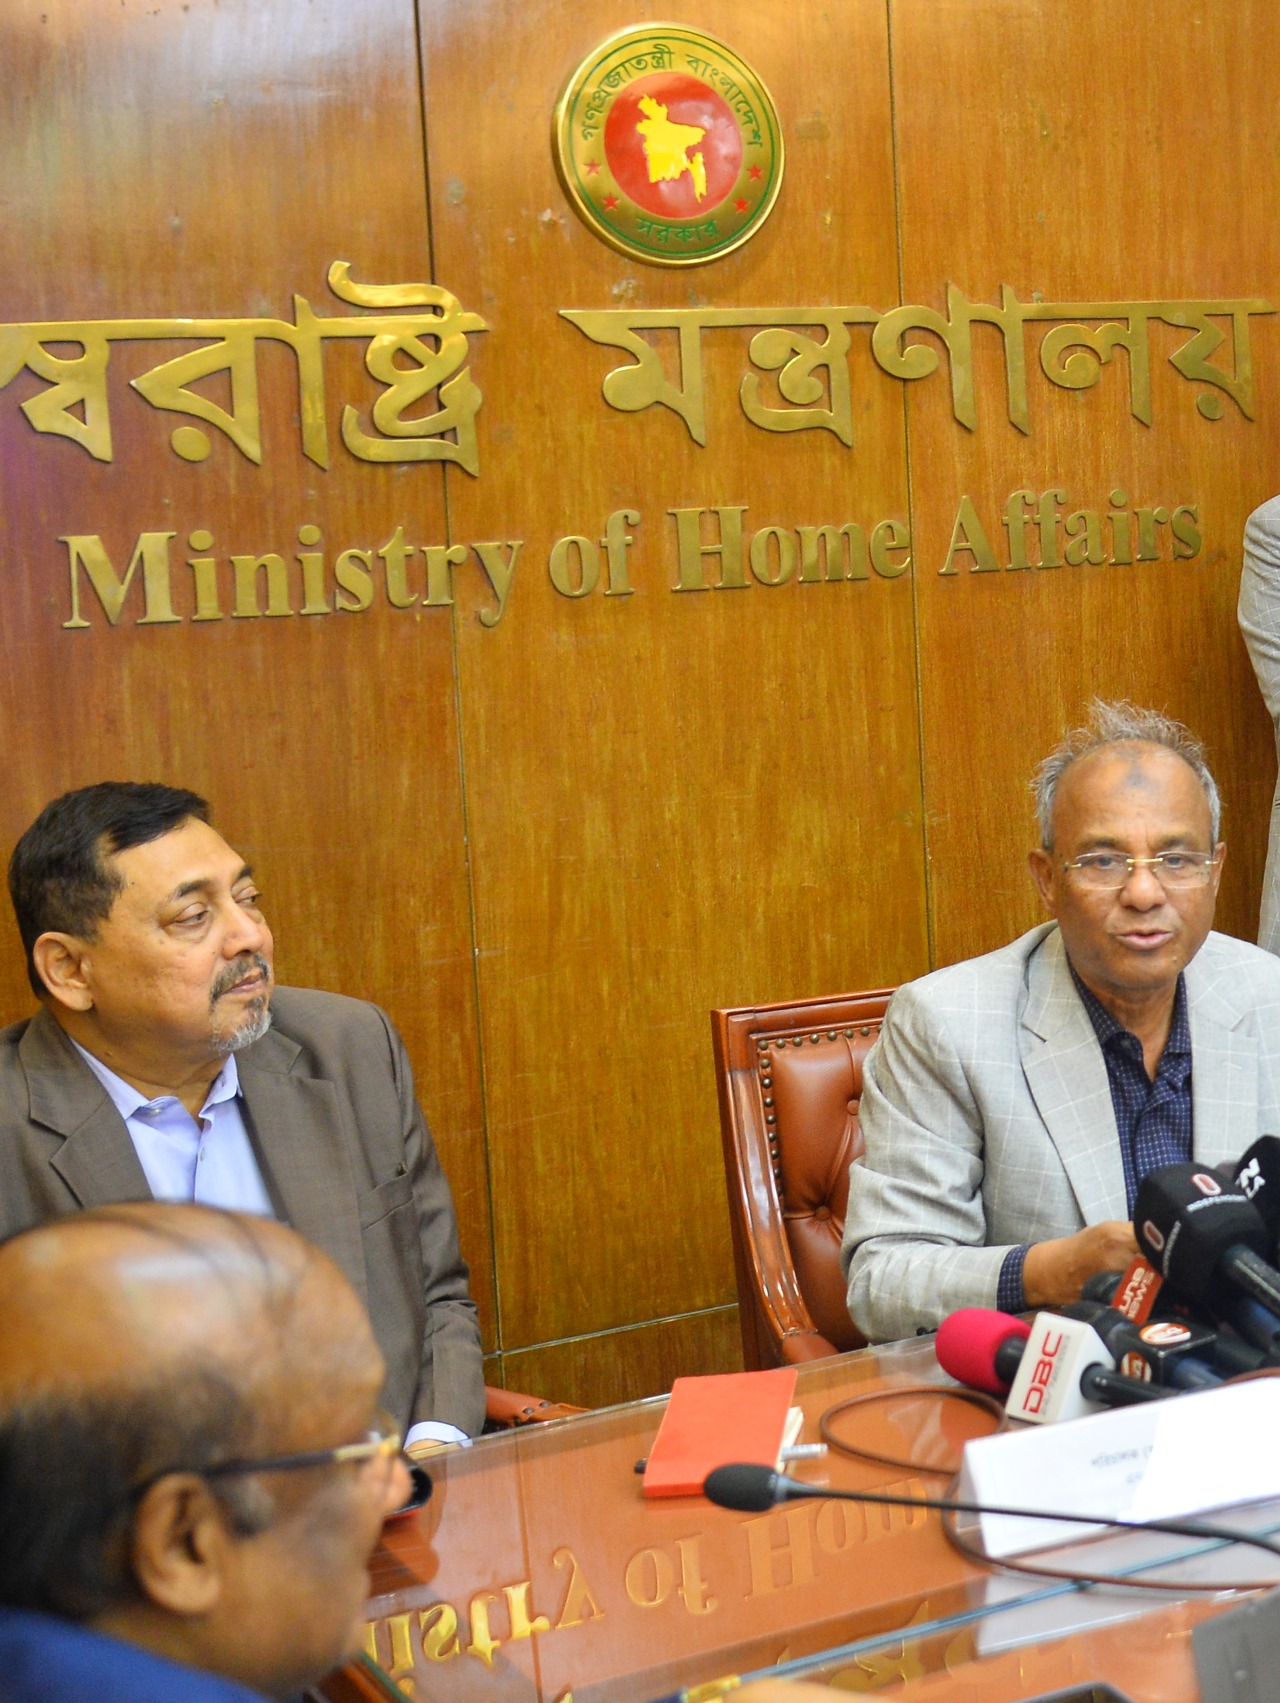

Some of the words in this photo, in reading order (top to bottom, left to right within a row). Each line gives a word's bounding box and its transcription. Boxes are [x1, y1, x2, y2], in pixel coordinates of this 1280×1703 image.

[685, 52, 763, 147] বাংলাদেশ
[635, 217, 721, 244] সরকার
[558, 281, 1279, 448] মন্ত্রণালয়
[58, 524, 524, 629] Ministry
[548, 508, 640, 598] of
[668, 506, 912, 594] Home
[938, 489, 1201, 577] Affairs
[1022, 1329, 1063, 1414] DBC
